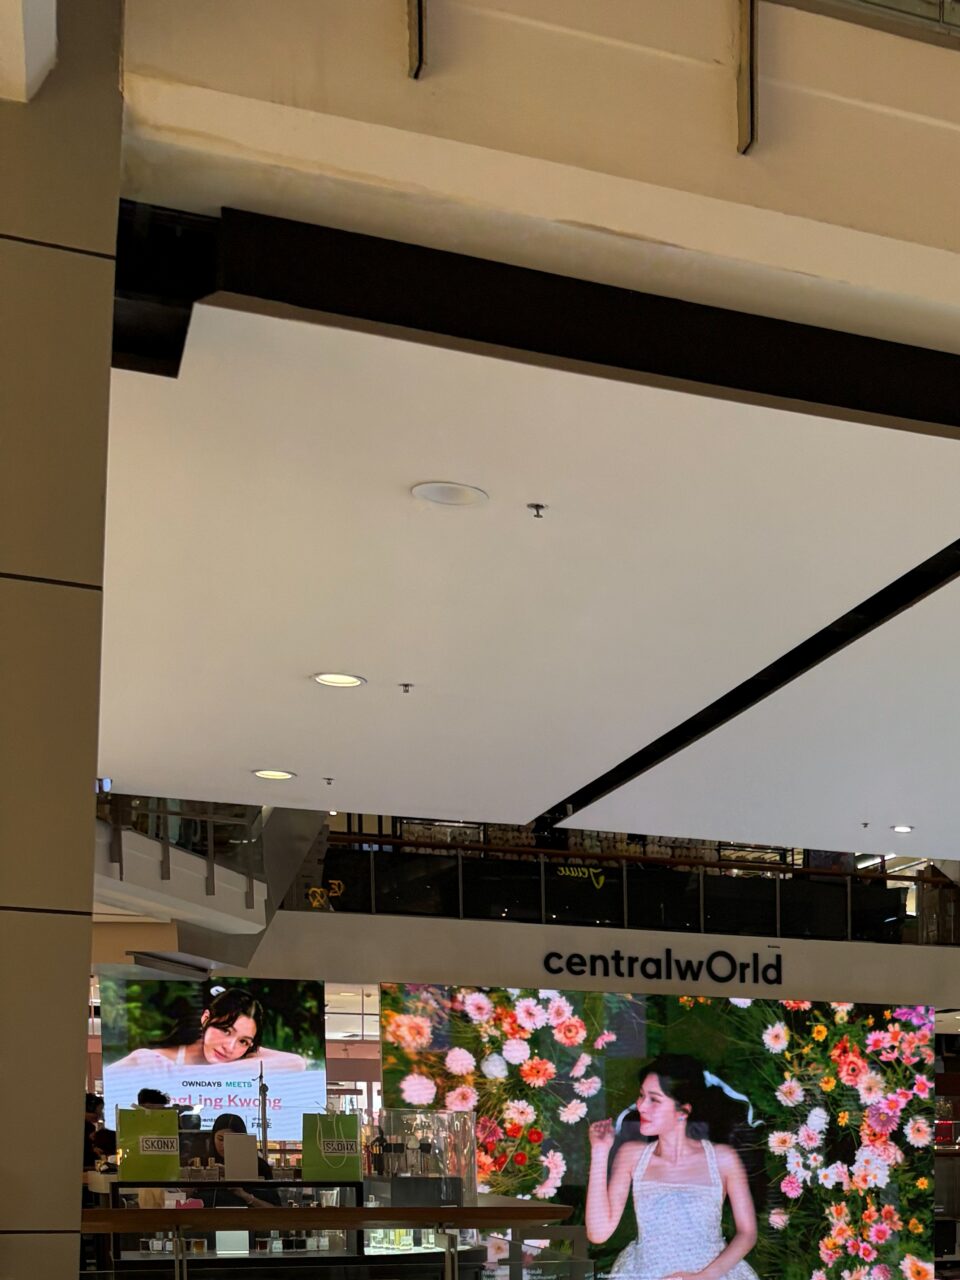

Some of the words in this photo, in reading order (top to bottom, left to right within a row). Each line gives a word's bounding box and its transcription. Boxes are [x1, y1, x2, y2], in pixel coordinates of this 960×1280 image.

[543, 948, 783, 985] centralwOrld
[182, 1080, 222, 1088] OWNDAYS
[144, 1138, 176, 1150] SKONX
